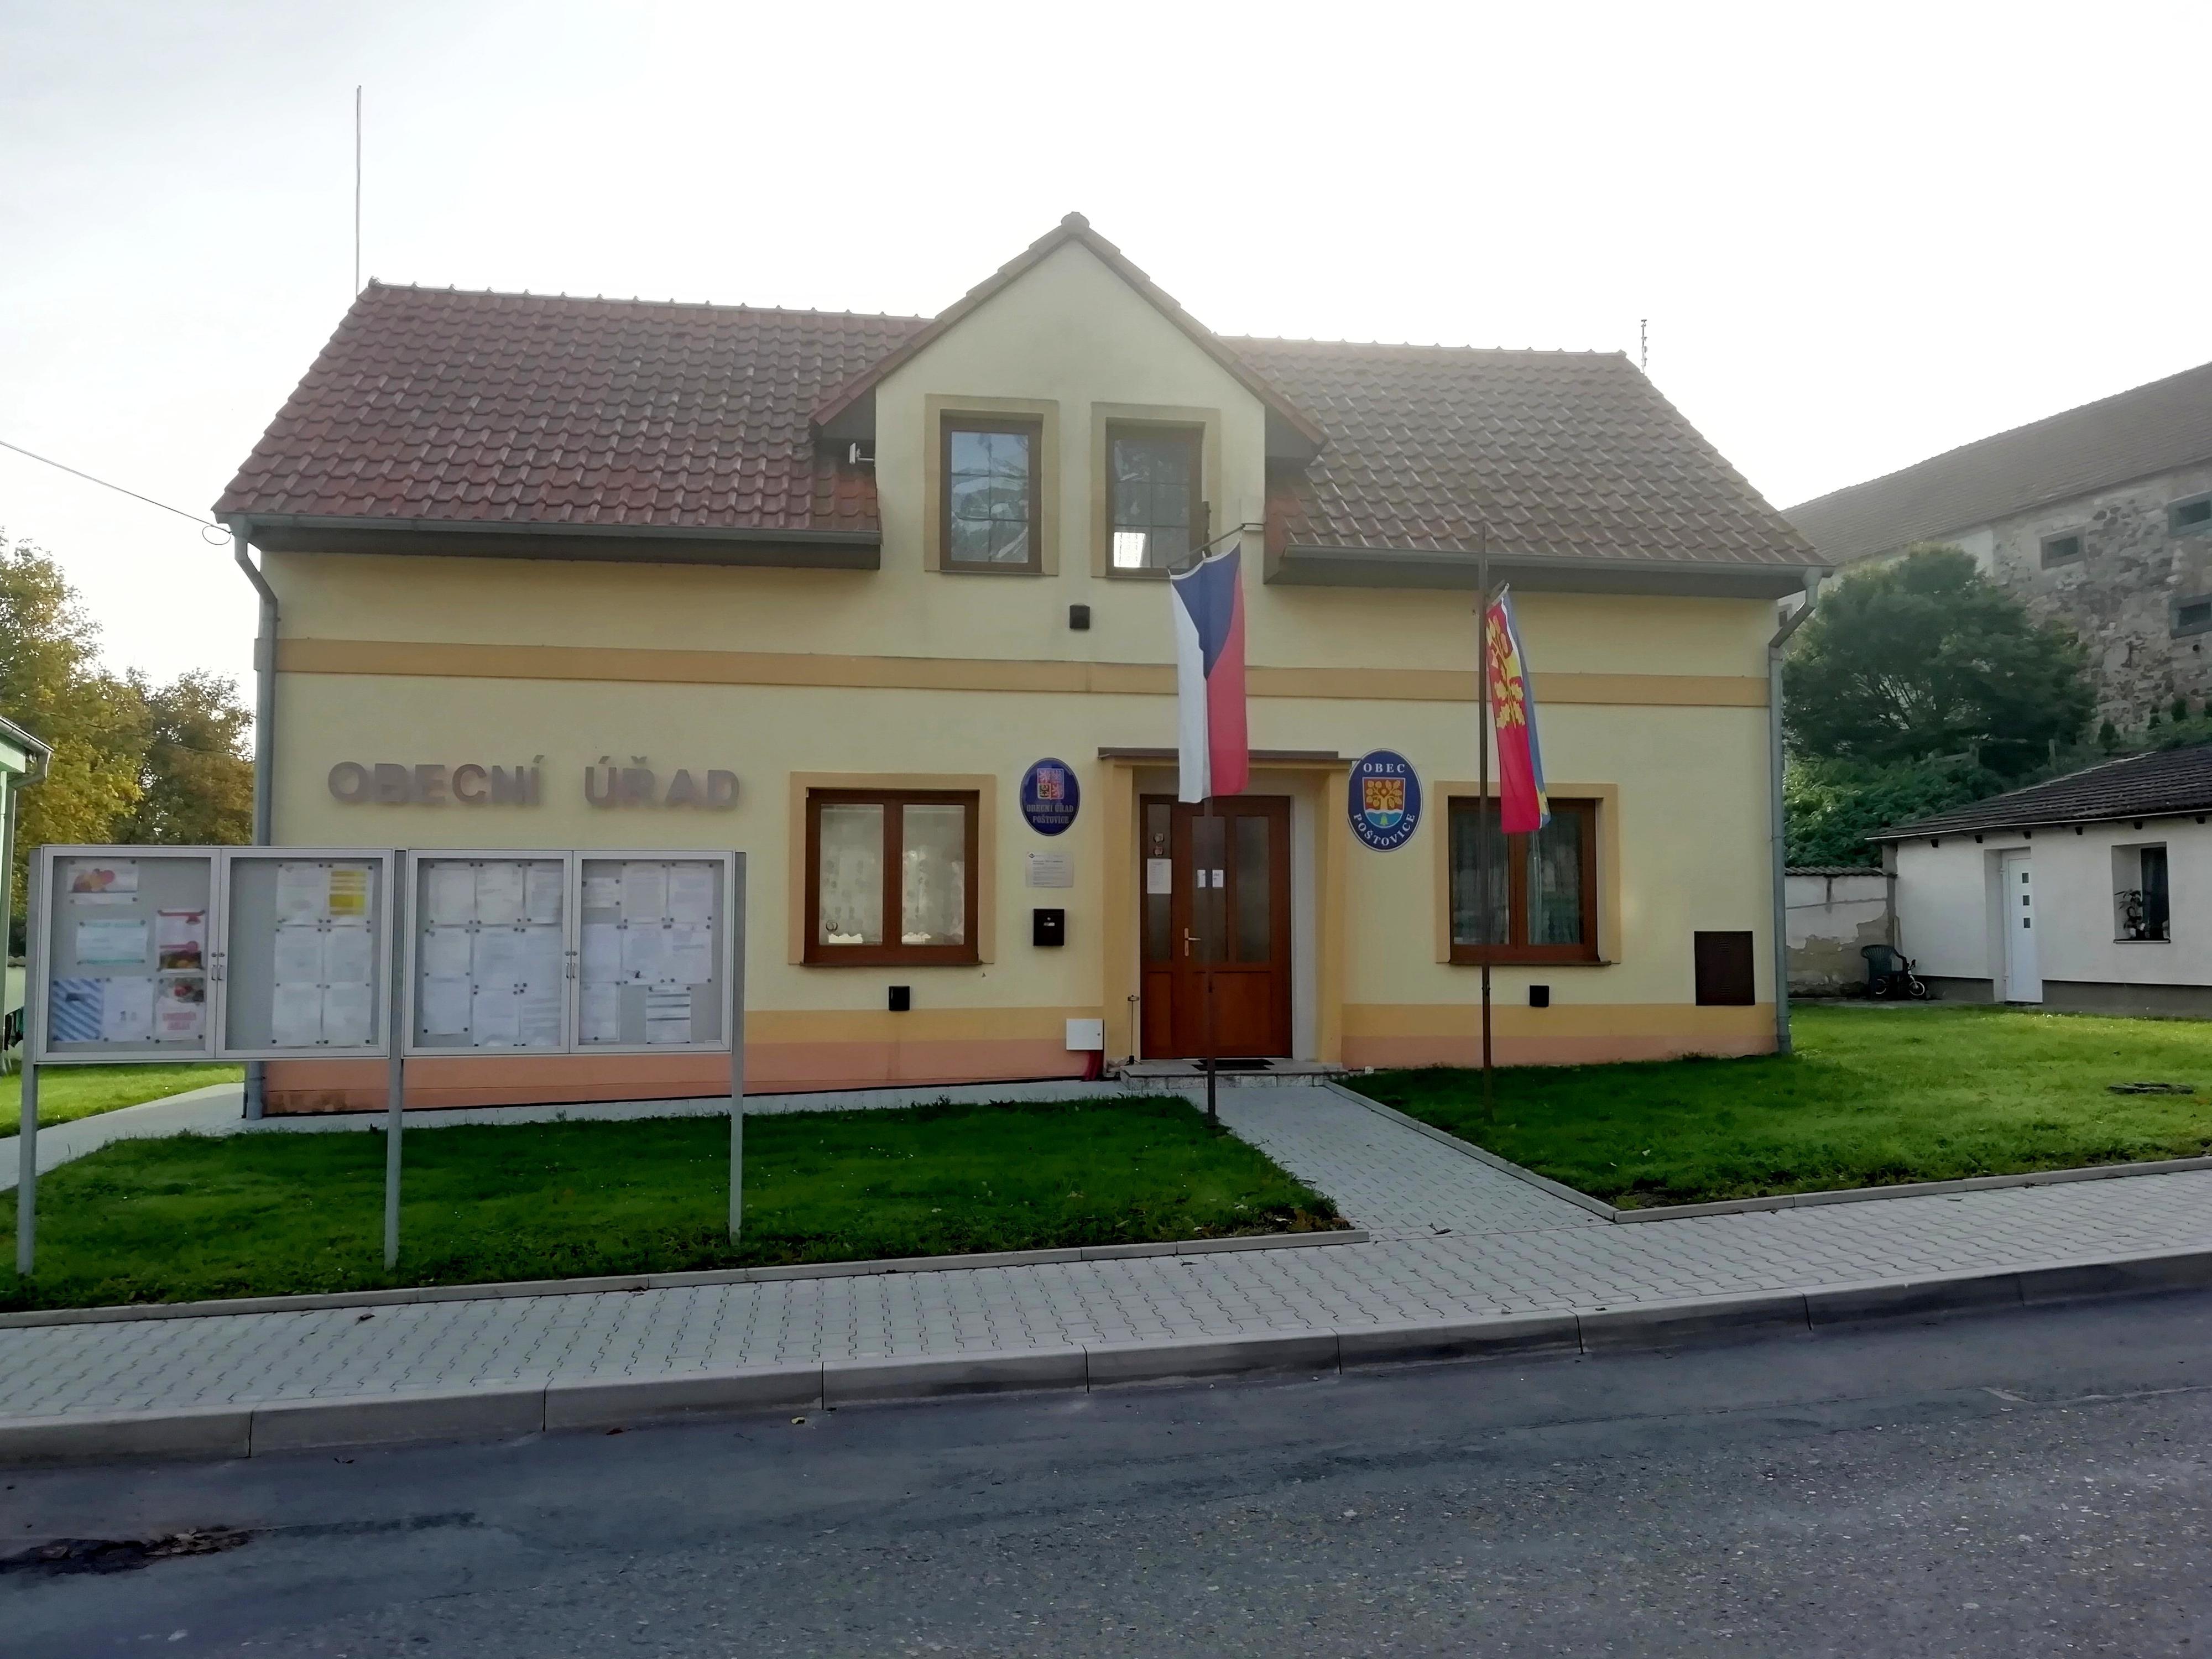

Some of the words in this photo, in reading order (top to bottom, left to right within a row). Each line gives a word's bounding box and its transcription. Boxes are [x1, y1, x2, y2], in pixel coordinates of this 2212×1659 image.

[1363, 763, 1405, 773] OBEC
[328, 754, 545, 805] OBECNÍ
[585, 755, 740, 810] ÚŘAD
[1032, 814, 1070, 824] POŠTOVICE
[1353, 813, 1415, 846] POŠTOVICE
